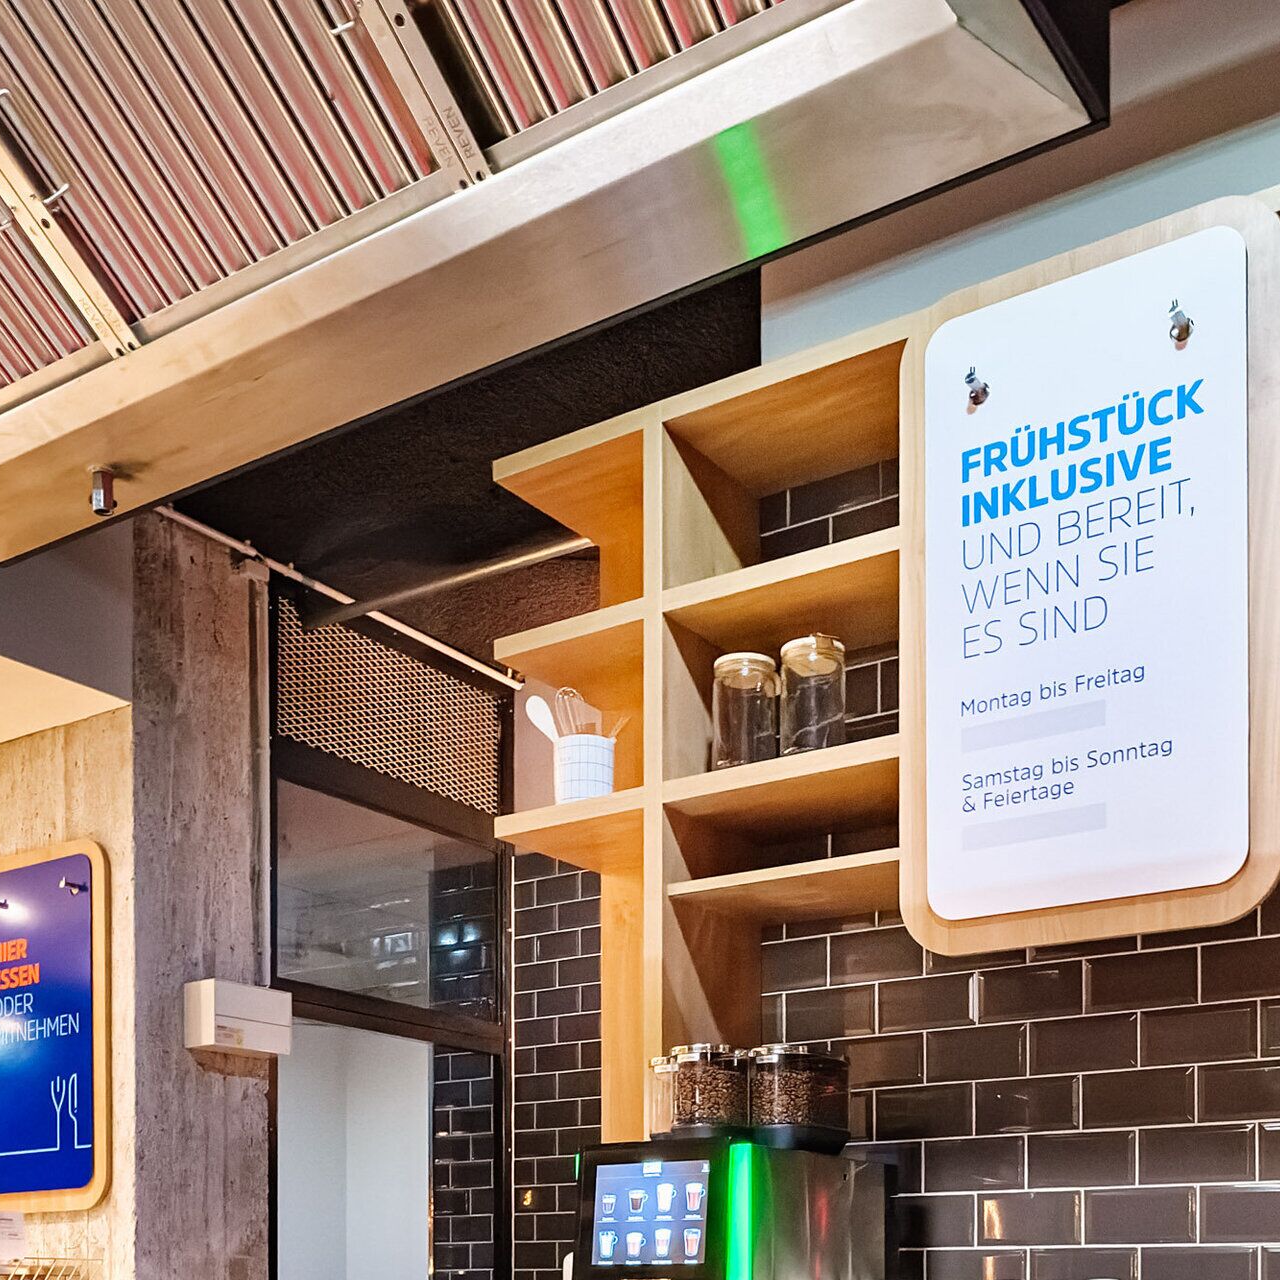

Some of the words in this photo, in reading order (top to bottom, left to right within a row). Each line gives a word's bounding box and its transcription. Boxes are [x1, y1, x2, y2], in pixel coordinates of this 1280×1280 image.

[961, 378, 1205, 484] FRÜHSTÜCK
[961, 435, 1172, 528] INKLUSIVE
[963, 521, 1041, 571] UND
[1057, 477, 1195, 547] BEREIT,
[961, 554, 1079, 614] WENN
[1098, 535, 1154, 582] SIE
[963, 619, 1003, 659] ES
[1018, 595, 1108, 646] SIND
[960, 689, 1032, 718] Montag
[1039, 681, 1067, 701] bis
[1075, 665, 1145, 693] Freitag
[962, 763, 1044, 791] Samstag
[1051, 755, 1079, 775] bis
[1086, 739, 1173, 769] Sonntag
[962, 795, 976, 813] &
[983, 781, 1075, 810] Feiertage
